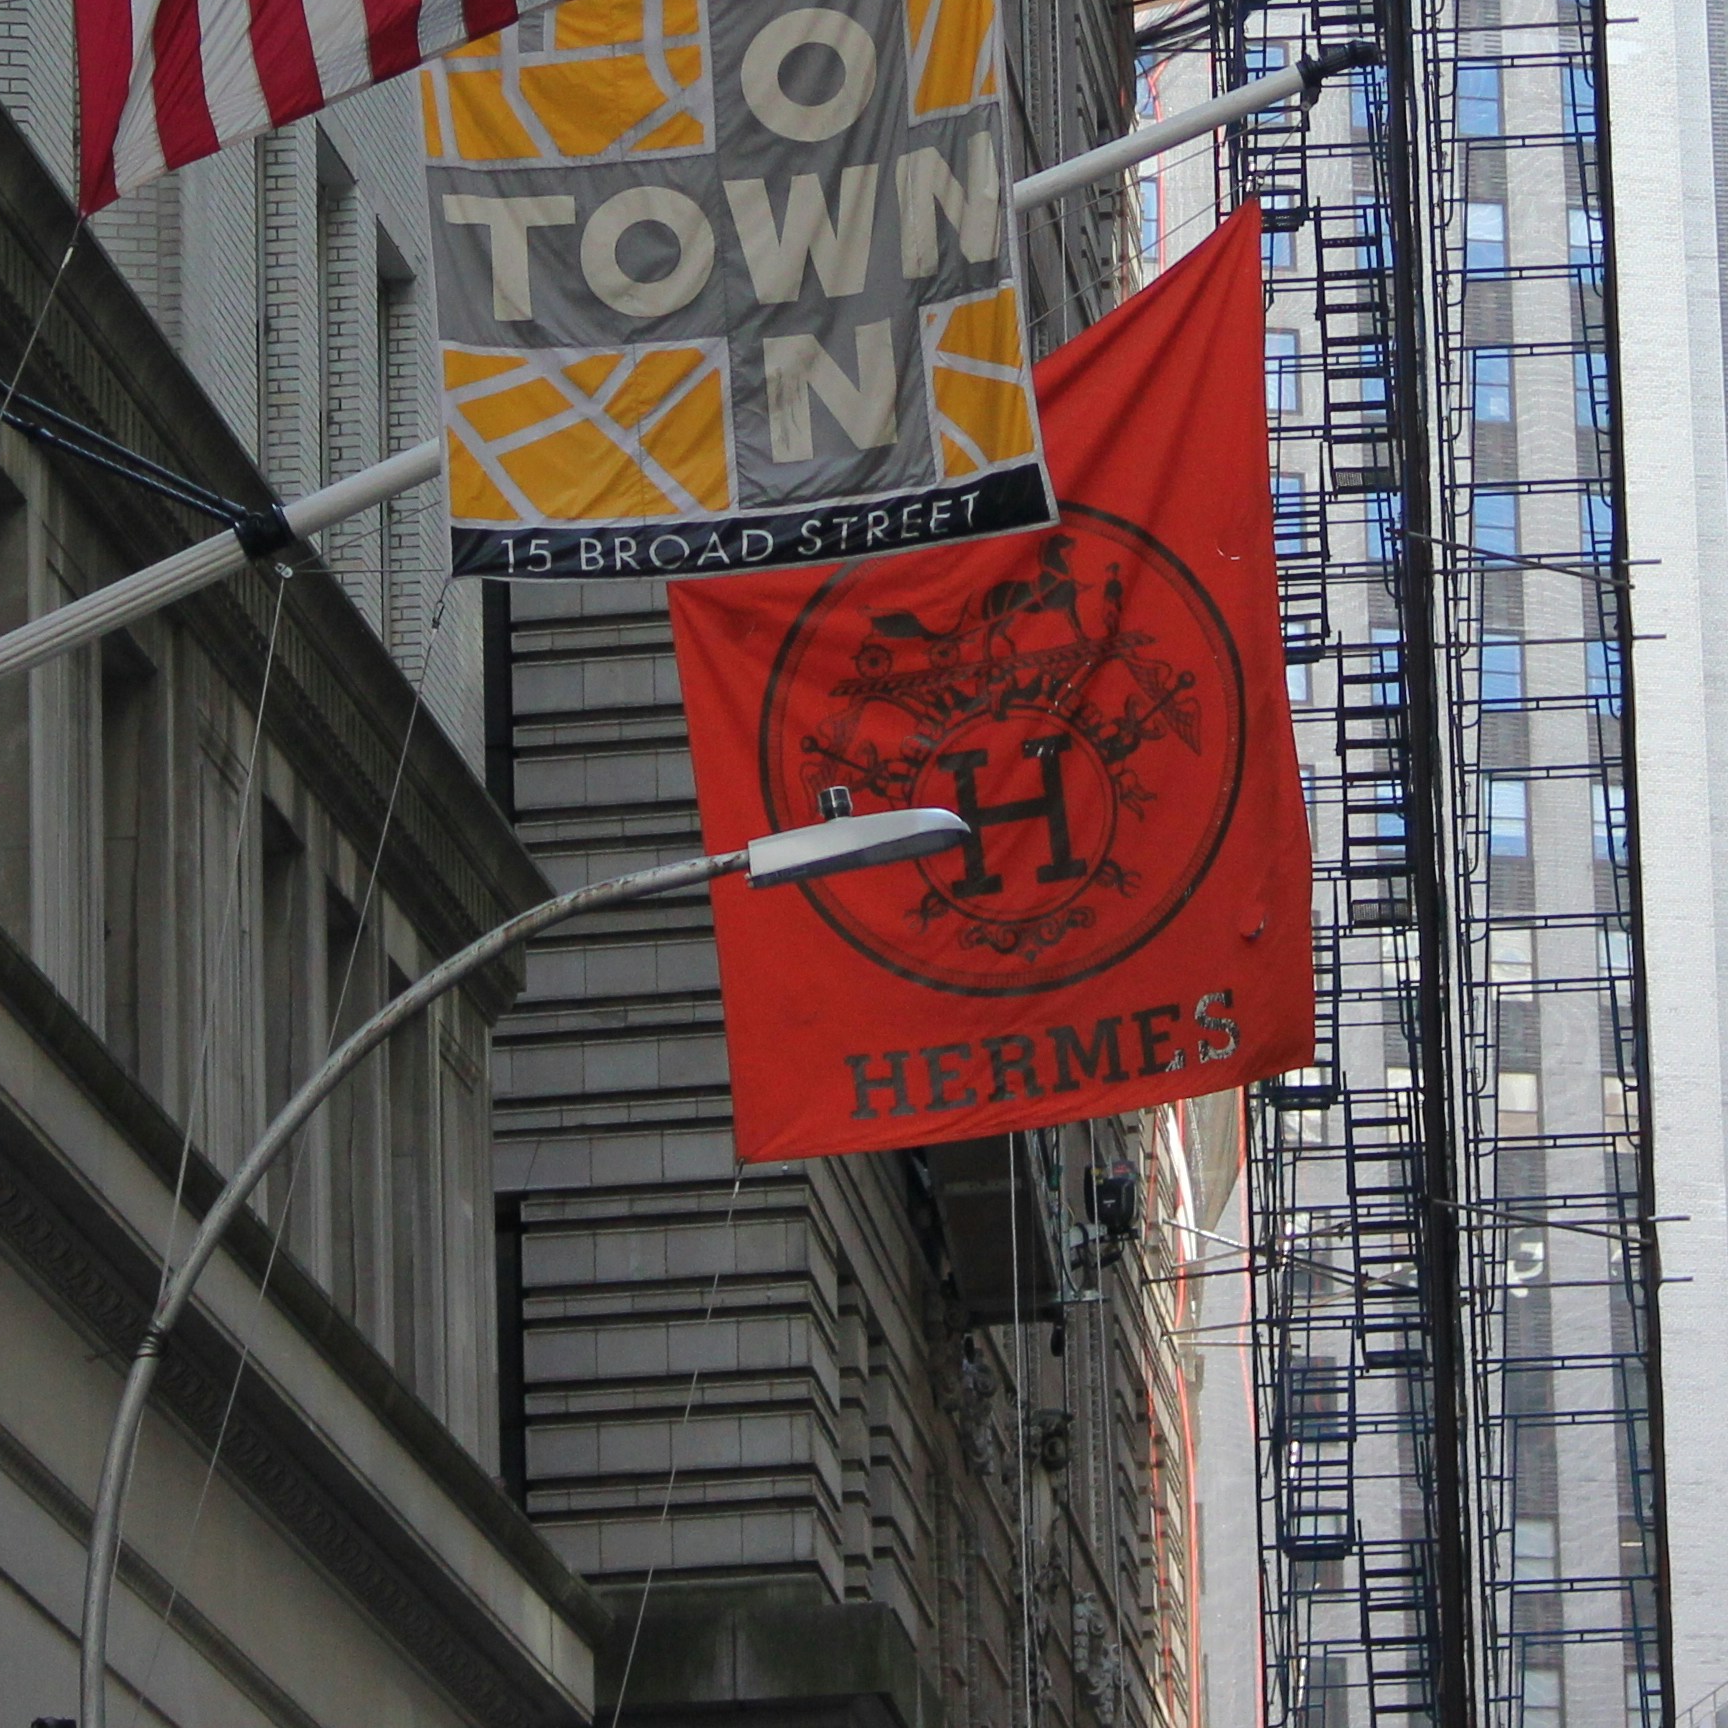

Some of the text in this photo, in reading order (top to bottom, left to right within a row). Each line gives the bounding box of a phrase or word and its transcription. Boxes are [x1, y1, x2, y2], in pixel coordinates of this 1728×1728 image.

[443, 132, 1000, 322] TOWN
[501, 491, 981, 574] 15 BROAD STREET
[936, 733, 1087, 899] H
[843, 988, 1241, 1120] HERMES
